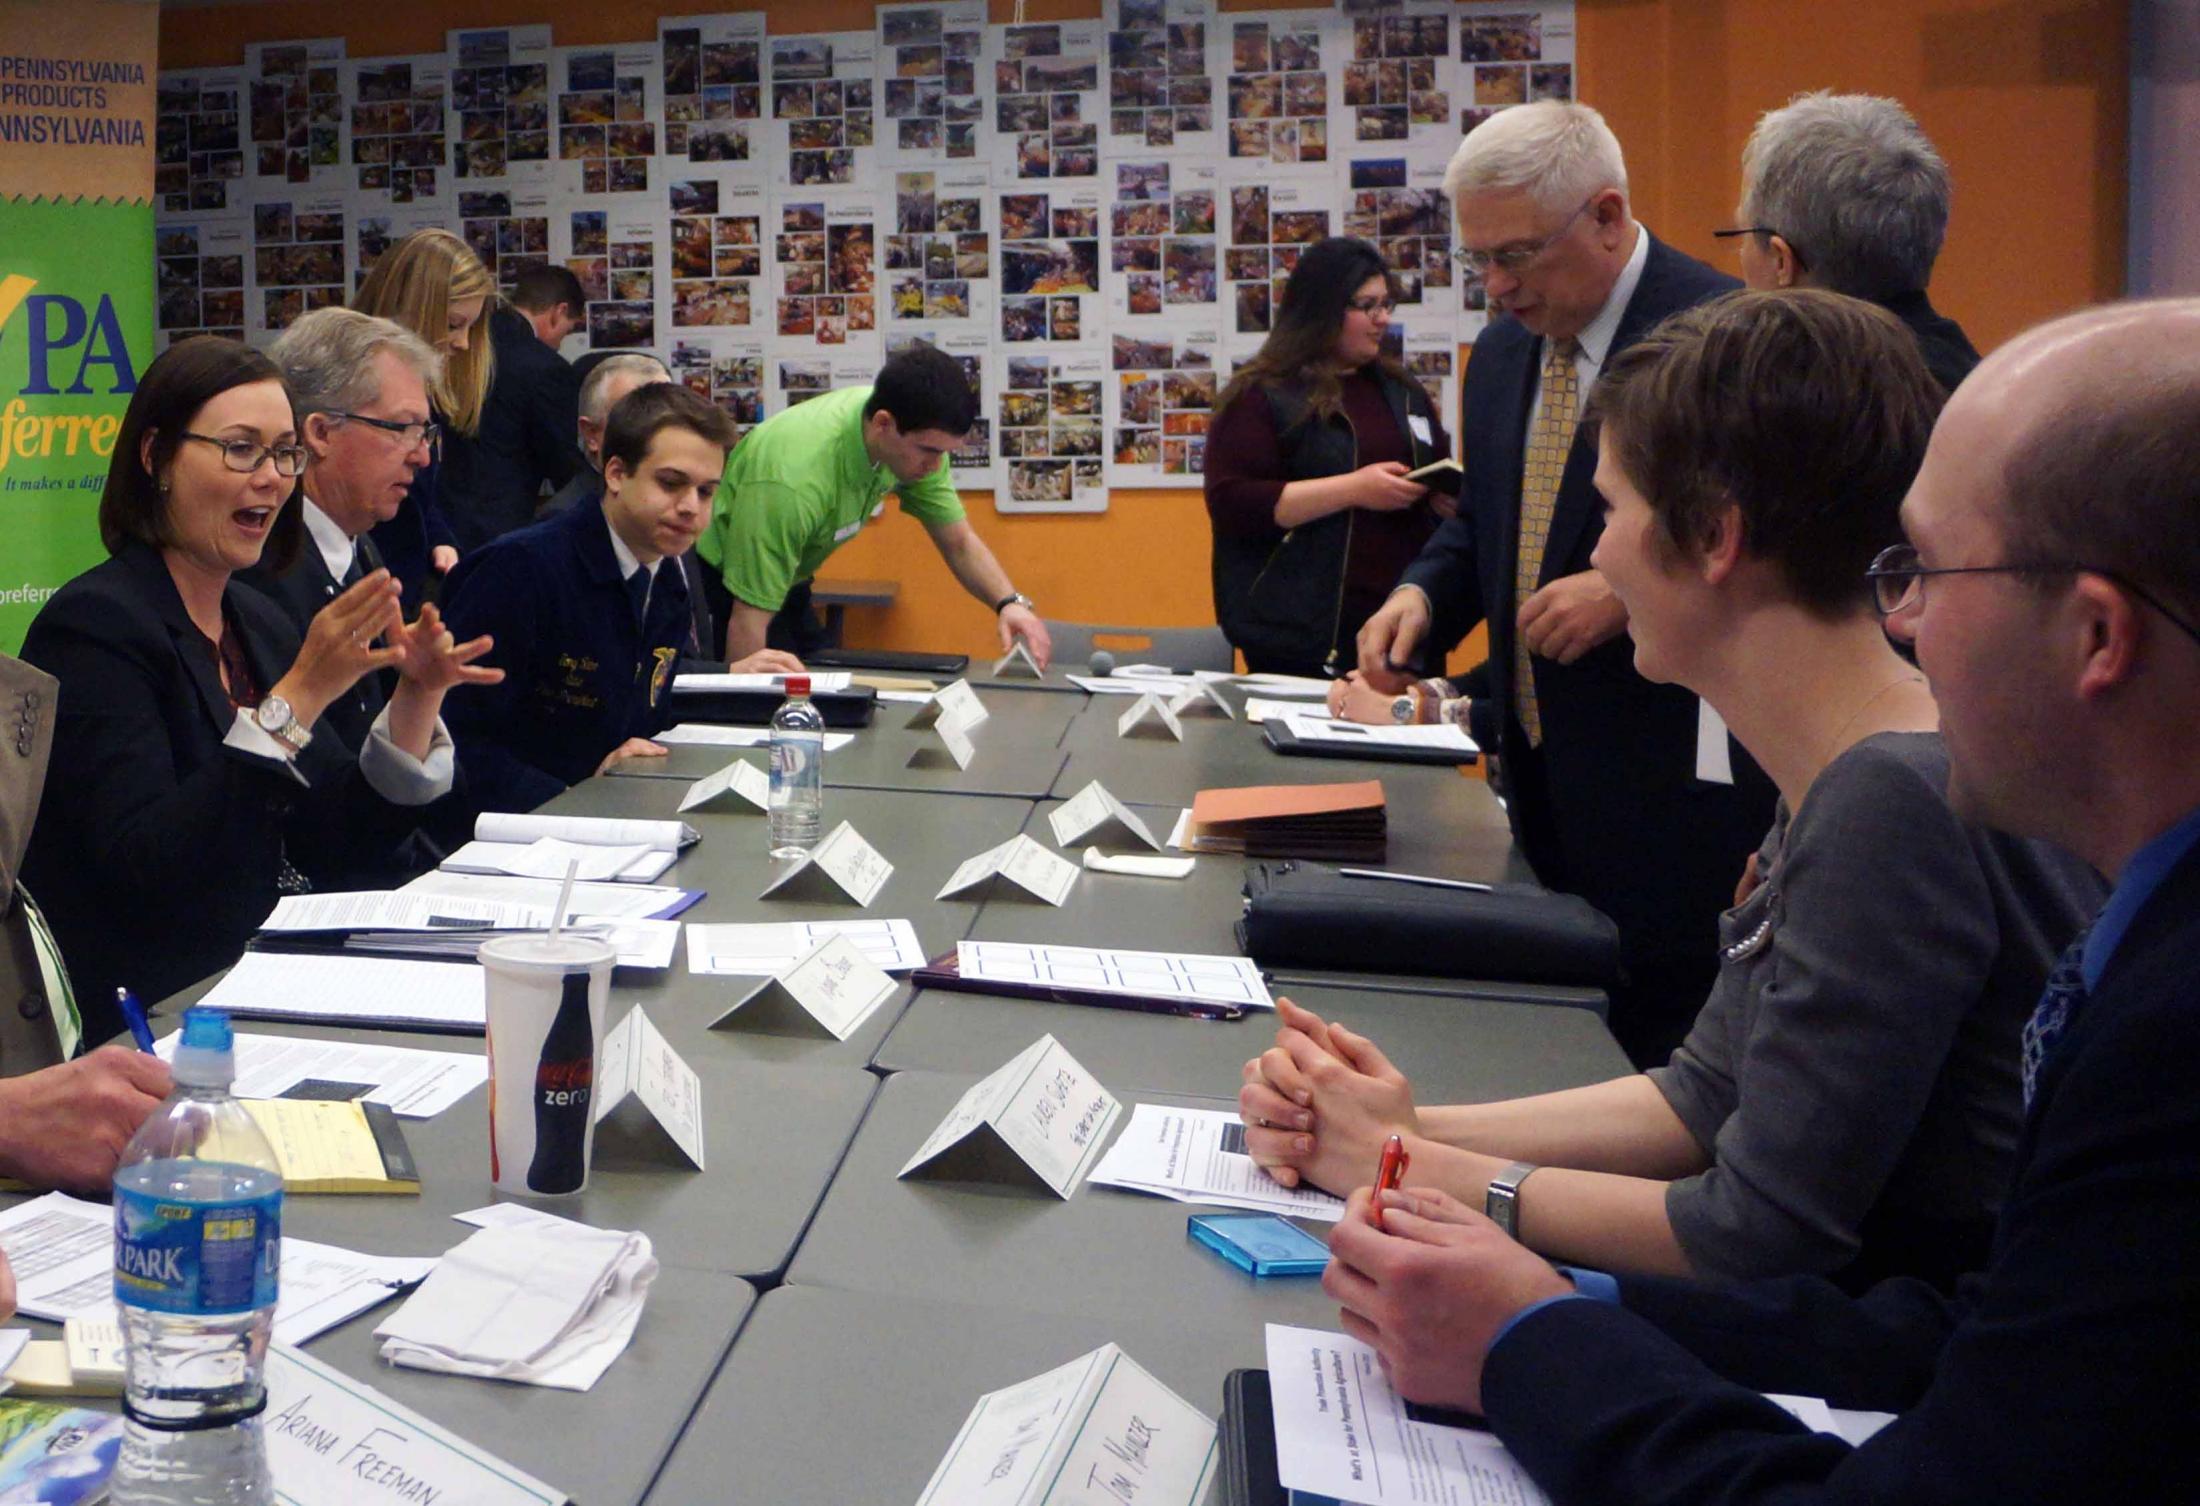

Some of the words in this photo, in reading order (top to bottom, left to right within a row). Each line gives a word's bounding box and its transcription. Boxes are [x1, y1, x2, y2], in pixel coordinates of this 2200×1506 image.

[1, 56, 145, 85] PENNSYLVANIA
[1, 82, 107, 109] PRODUCTS
[18, 293, 139, 394] PA
[0, 398, 122, 473] ferre
[5, 476, 16, 491] It
[20, 475, 62, 490] makes
[67, 479, 76, 489] a
[80, 474, 107, 493] diff
[545, 1088, 589, 1106] zero
[124, 1245, 184, 1282] PARK
[265, 1394, 340, 1456] ARIANA
[336, 1427, 442, 1506] FREEMAN
